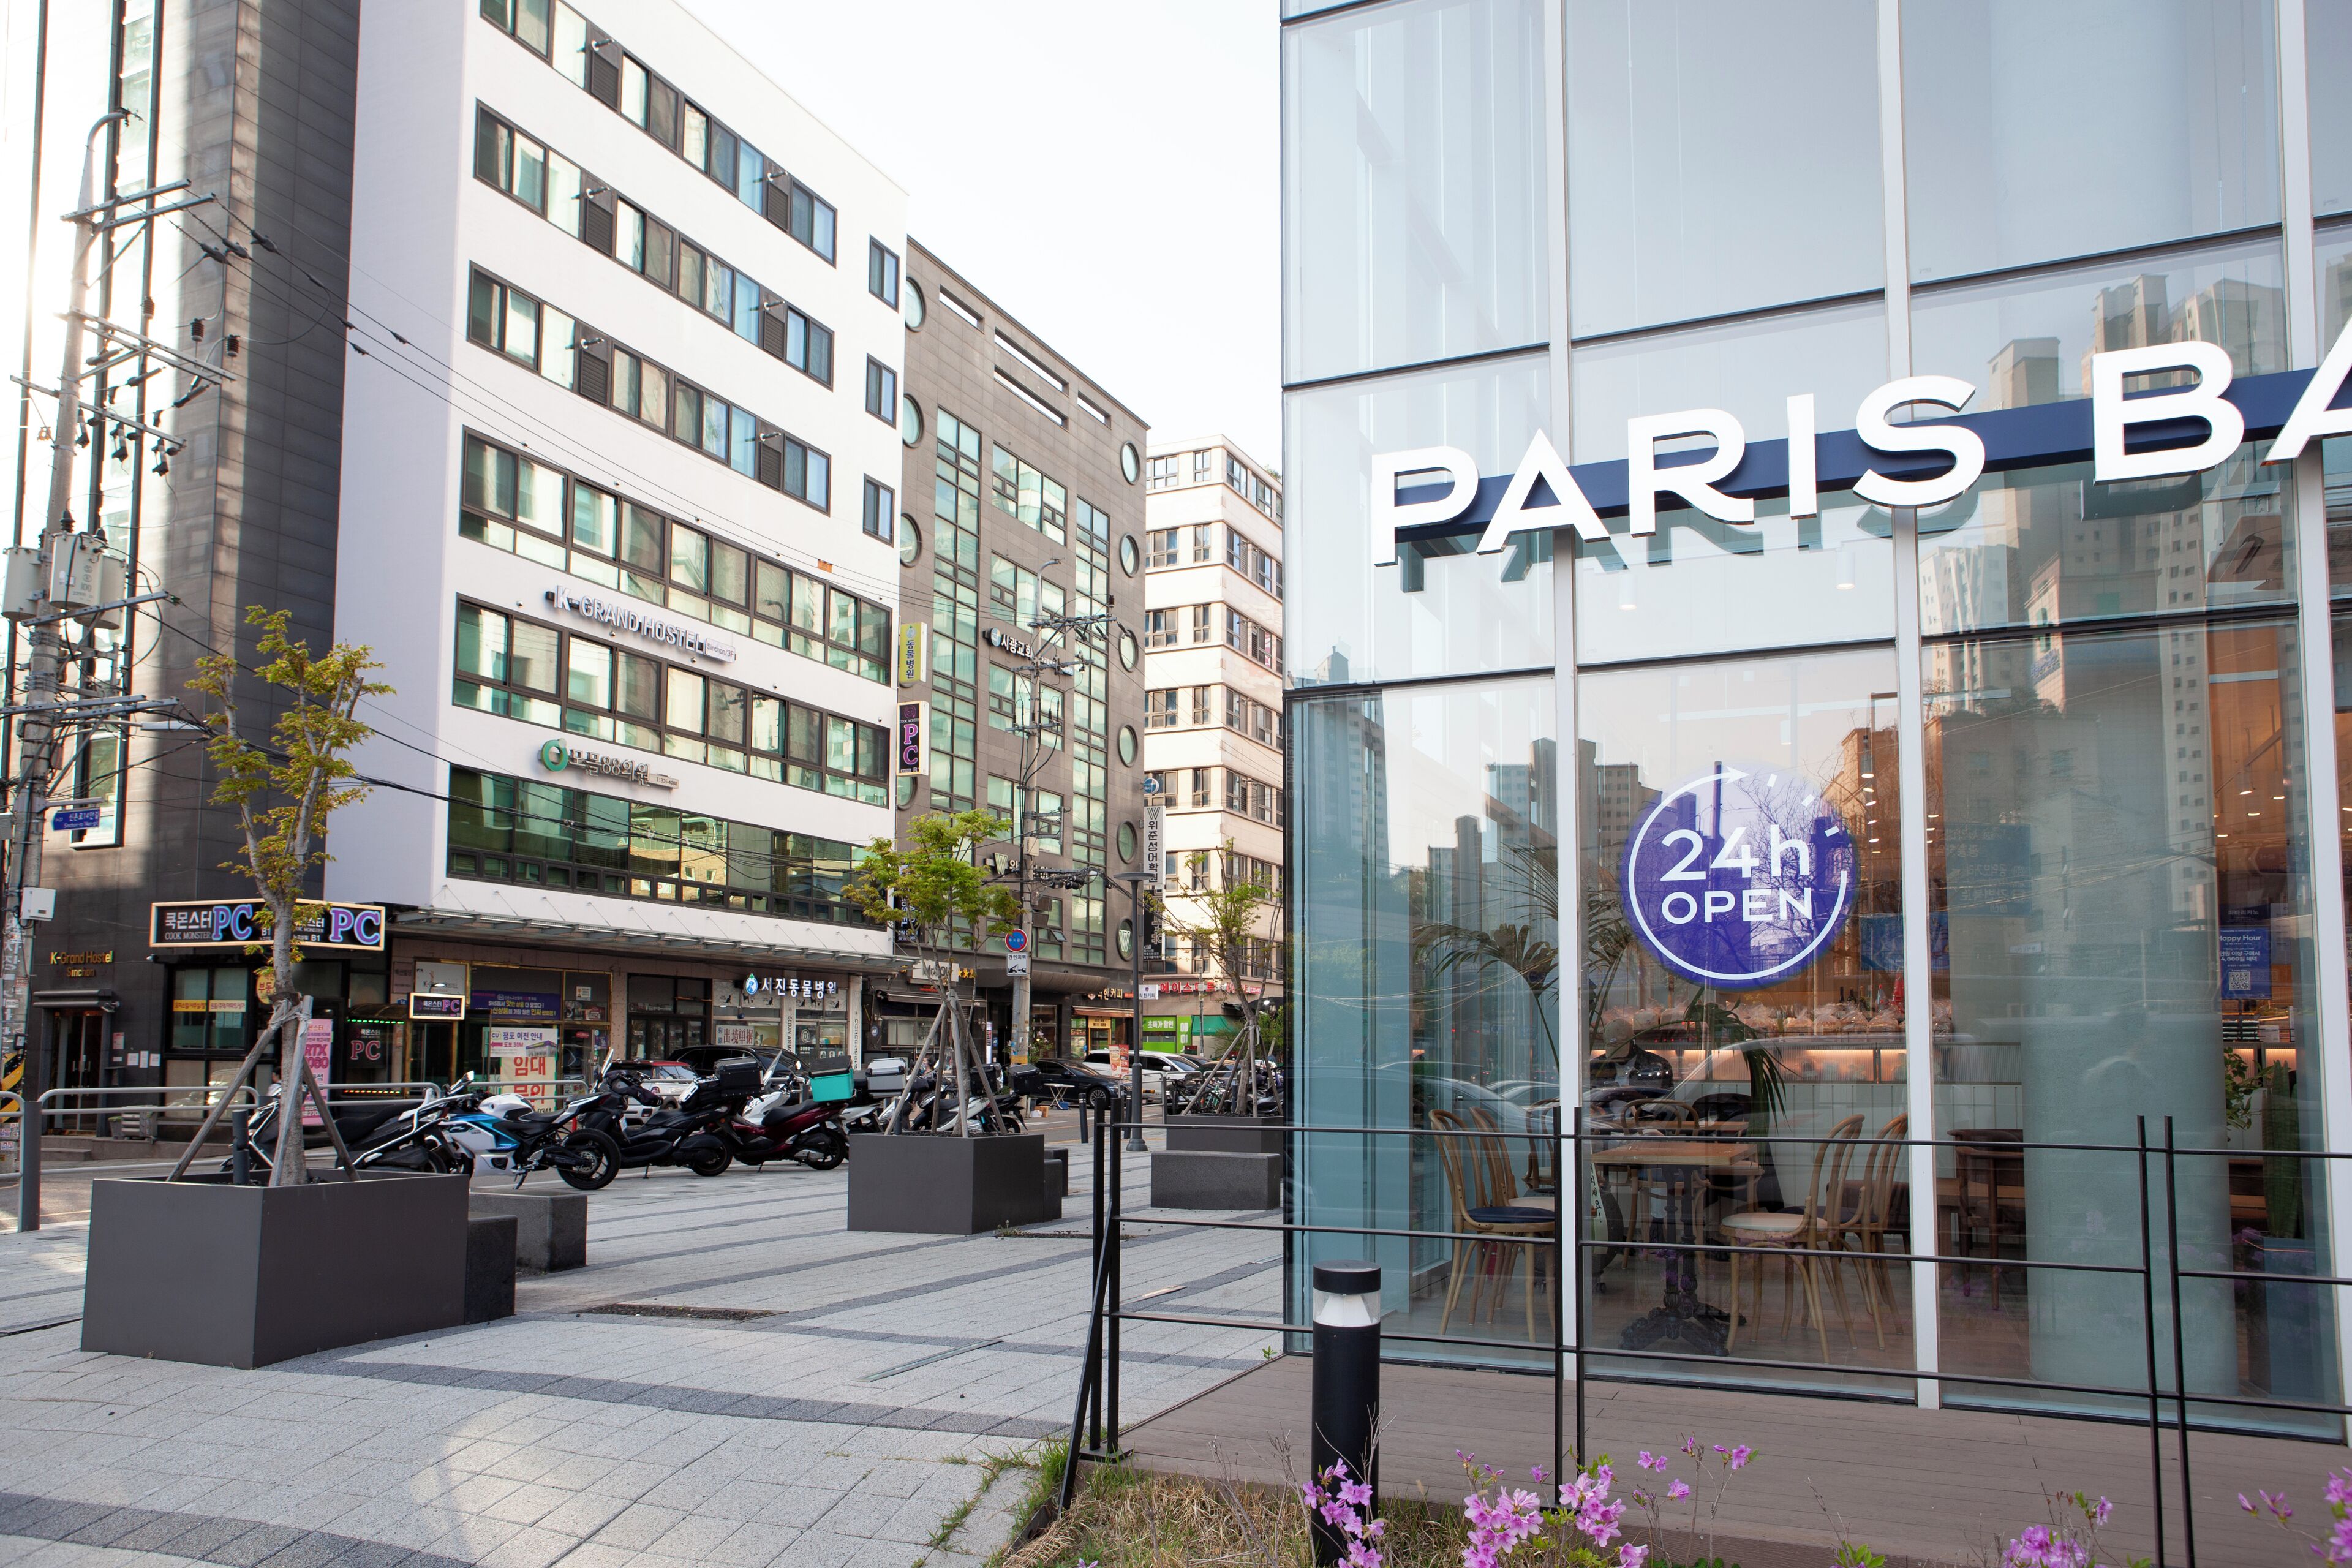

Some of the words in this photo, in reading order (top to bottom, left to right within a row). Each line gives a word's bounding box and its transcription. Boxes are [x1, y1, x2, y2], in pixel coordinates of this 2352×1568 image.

[1372, 374, 1988, 567] PARIS
[554, 585, 639, 632] K-GRAND
[643, 616, 704, 654] HOSTEL
[906, 640, 914, 679] 동물병원
[903, 723, 919, 765] PC
[1660, 824, 1810, 881] 24h
[1661, 888, 1812, 924] OPEN
[165, 911, 212, 929] 쿡몬스터
[212, 904, 254, 941] PC
[262, 927, 271, 936] B1
[329, 908, 381, 945] PC
[165, 932, 182, 940] COOK
[183, 931, 211, 940] MONSTER
[50, 951, 85, 965] K-Grand
[86, 950, 114, 963] Hostel
[67, 967, 95, 977] Sinchon
[259, 982, 276, 994] 부동
[761, 977, 838, 1000] 서진동물병원
[442, 999, 460, 1012] PC
[502, 1031, 515, 1040] 점포
[516, 1031, 529, 1041] 이전
[530, 1032, 543, 1041] 안내
[304, 1044, 328, 1057] RTX
[350, 1040, 381, 1060] PC
[513, 1057, 546, 1077] 임대
